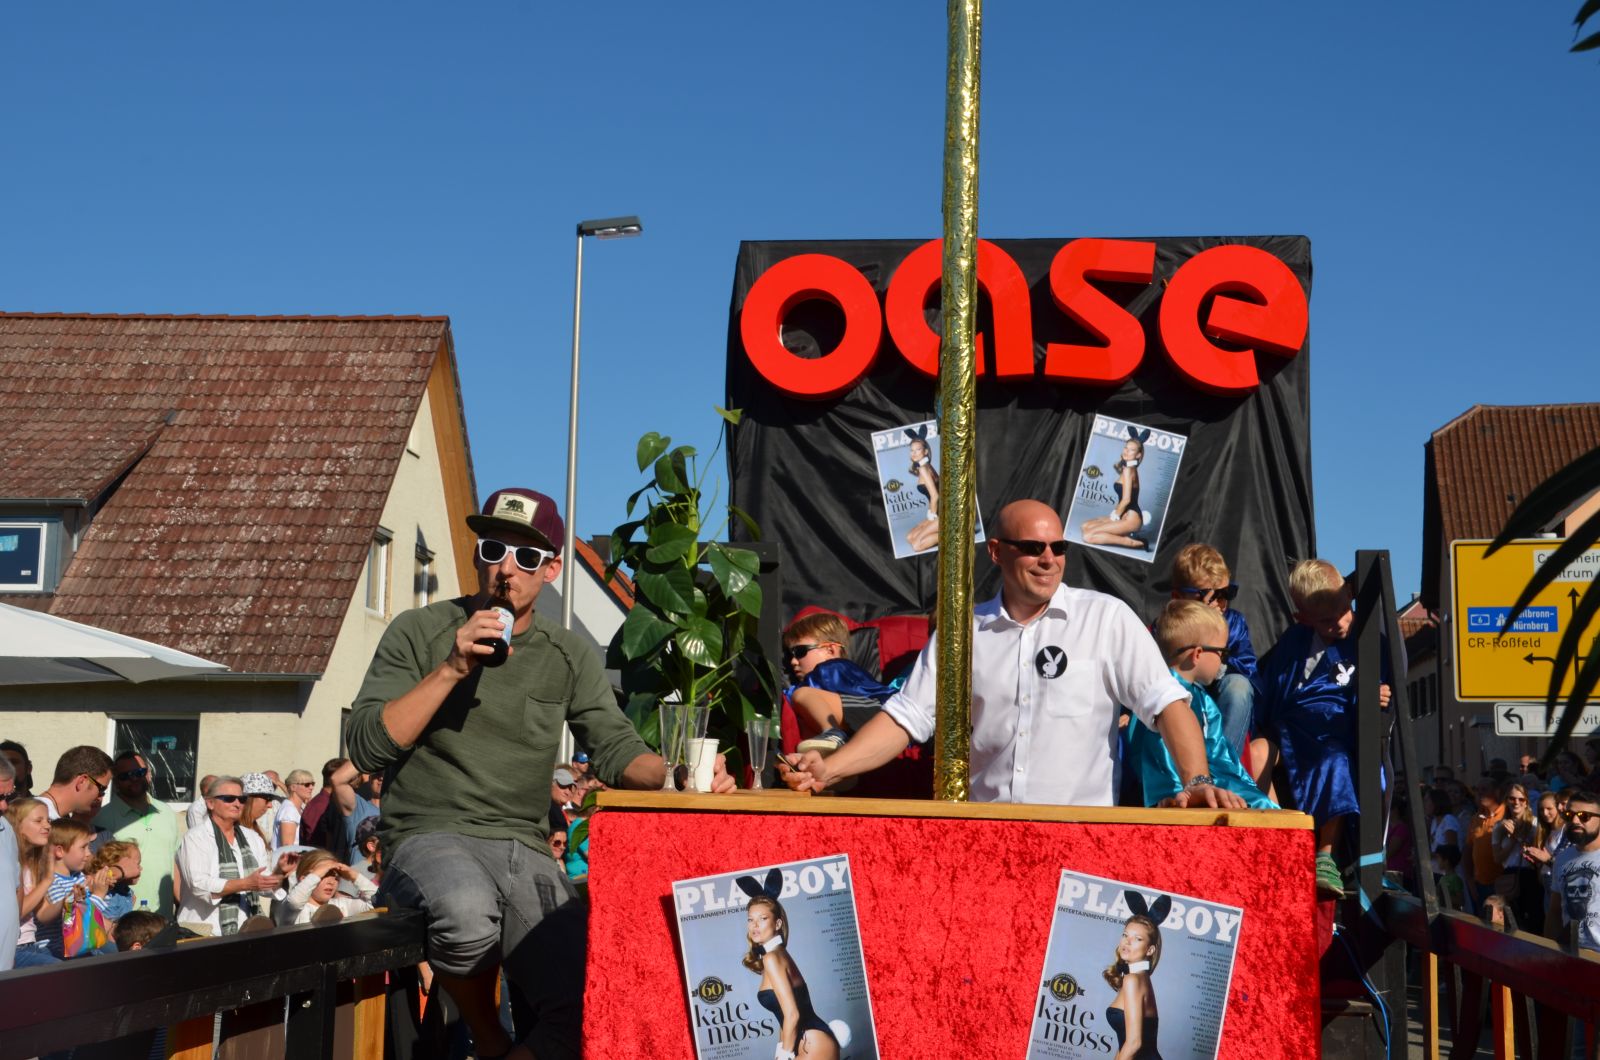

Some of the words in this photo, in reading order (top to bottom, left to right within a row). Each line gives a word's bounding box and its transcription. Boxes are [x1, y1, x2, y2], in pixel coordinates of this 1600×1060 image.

[741, 238, 1308, 397] oase
[1079, 476, 1108, 493] kate
[885, 490, 913, 505] kate
[1081, 488, 1116, 505] moss
[891, 498, 927, 513] moss
[1513, 621, 1549, 632] Nürnberg
[1468, 637, 1541, 648] CR-Roßfeld
[680, 910, 727, 922] ENTERTAINMENT
[1057, 906, 1105, 921] ENTERTAINMENT
[701, 982, 722, 997] 60
[1053, 979, 1075, 995] 60
[695, 1001, 750, 1027] kate
[1038, 995, 1095, 1029] kate
[707, 1018, 774, 1045] moss
[1044, 1022, 1113, 1054] moss
